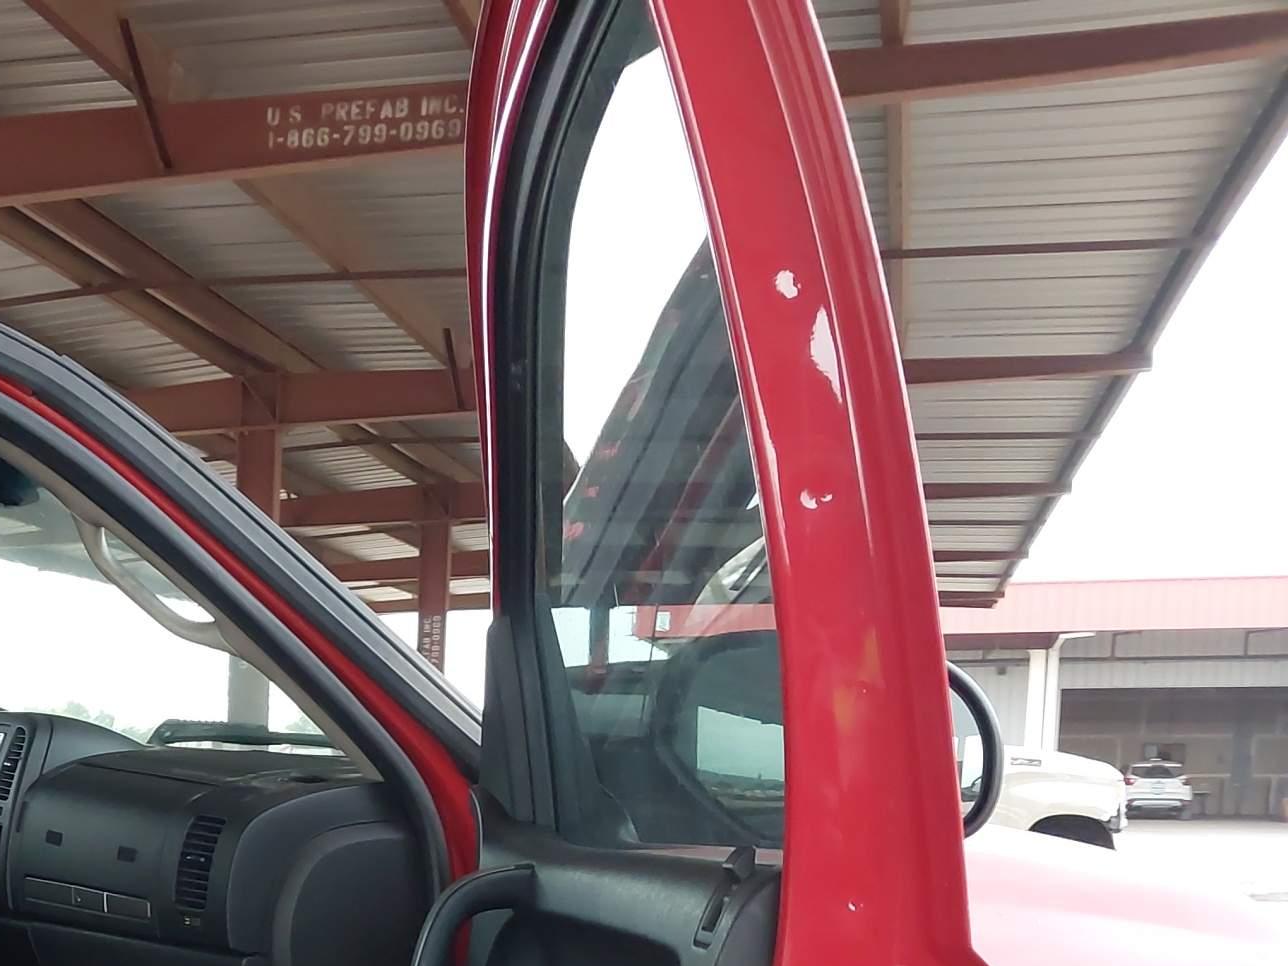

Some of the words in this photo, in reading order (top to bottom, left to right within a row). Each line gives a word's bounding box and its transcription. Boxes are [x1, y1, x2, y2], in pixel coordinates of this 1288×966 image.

[321, 97, 409, 121] PREFAB
[420, 94, 465, 116] INC.
[268, 118, 462, 150] 1-866-799-0969
